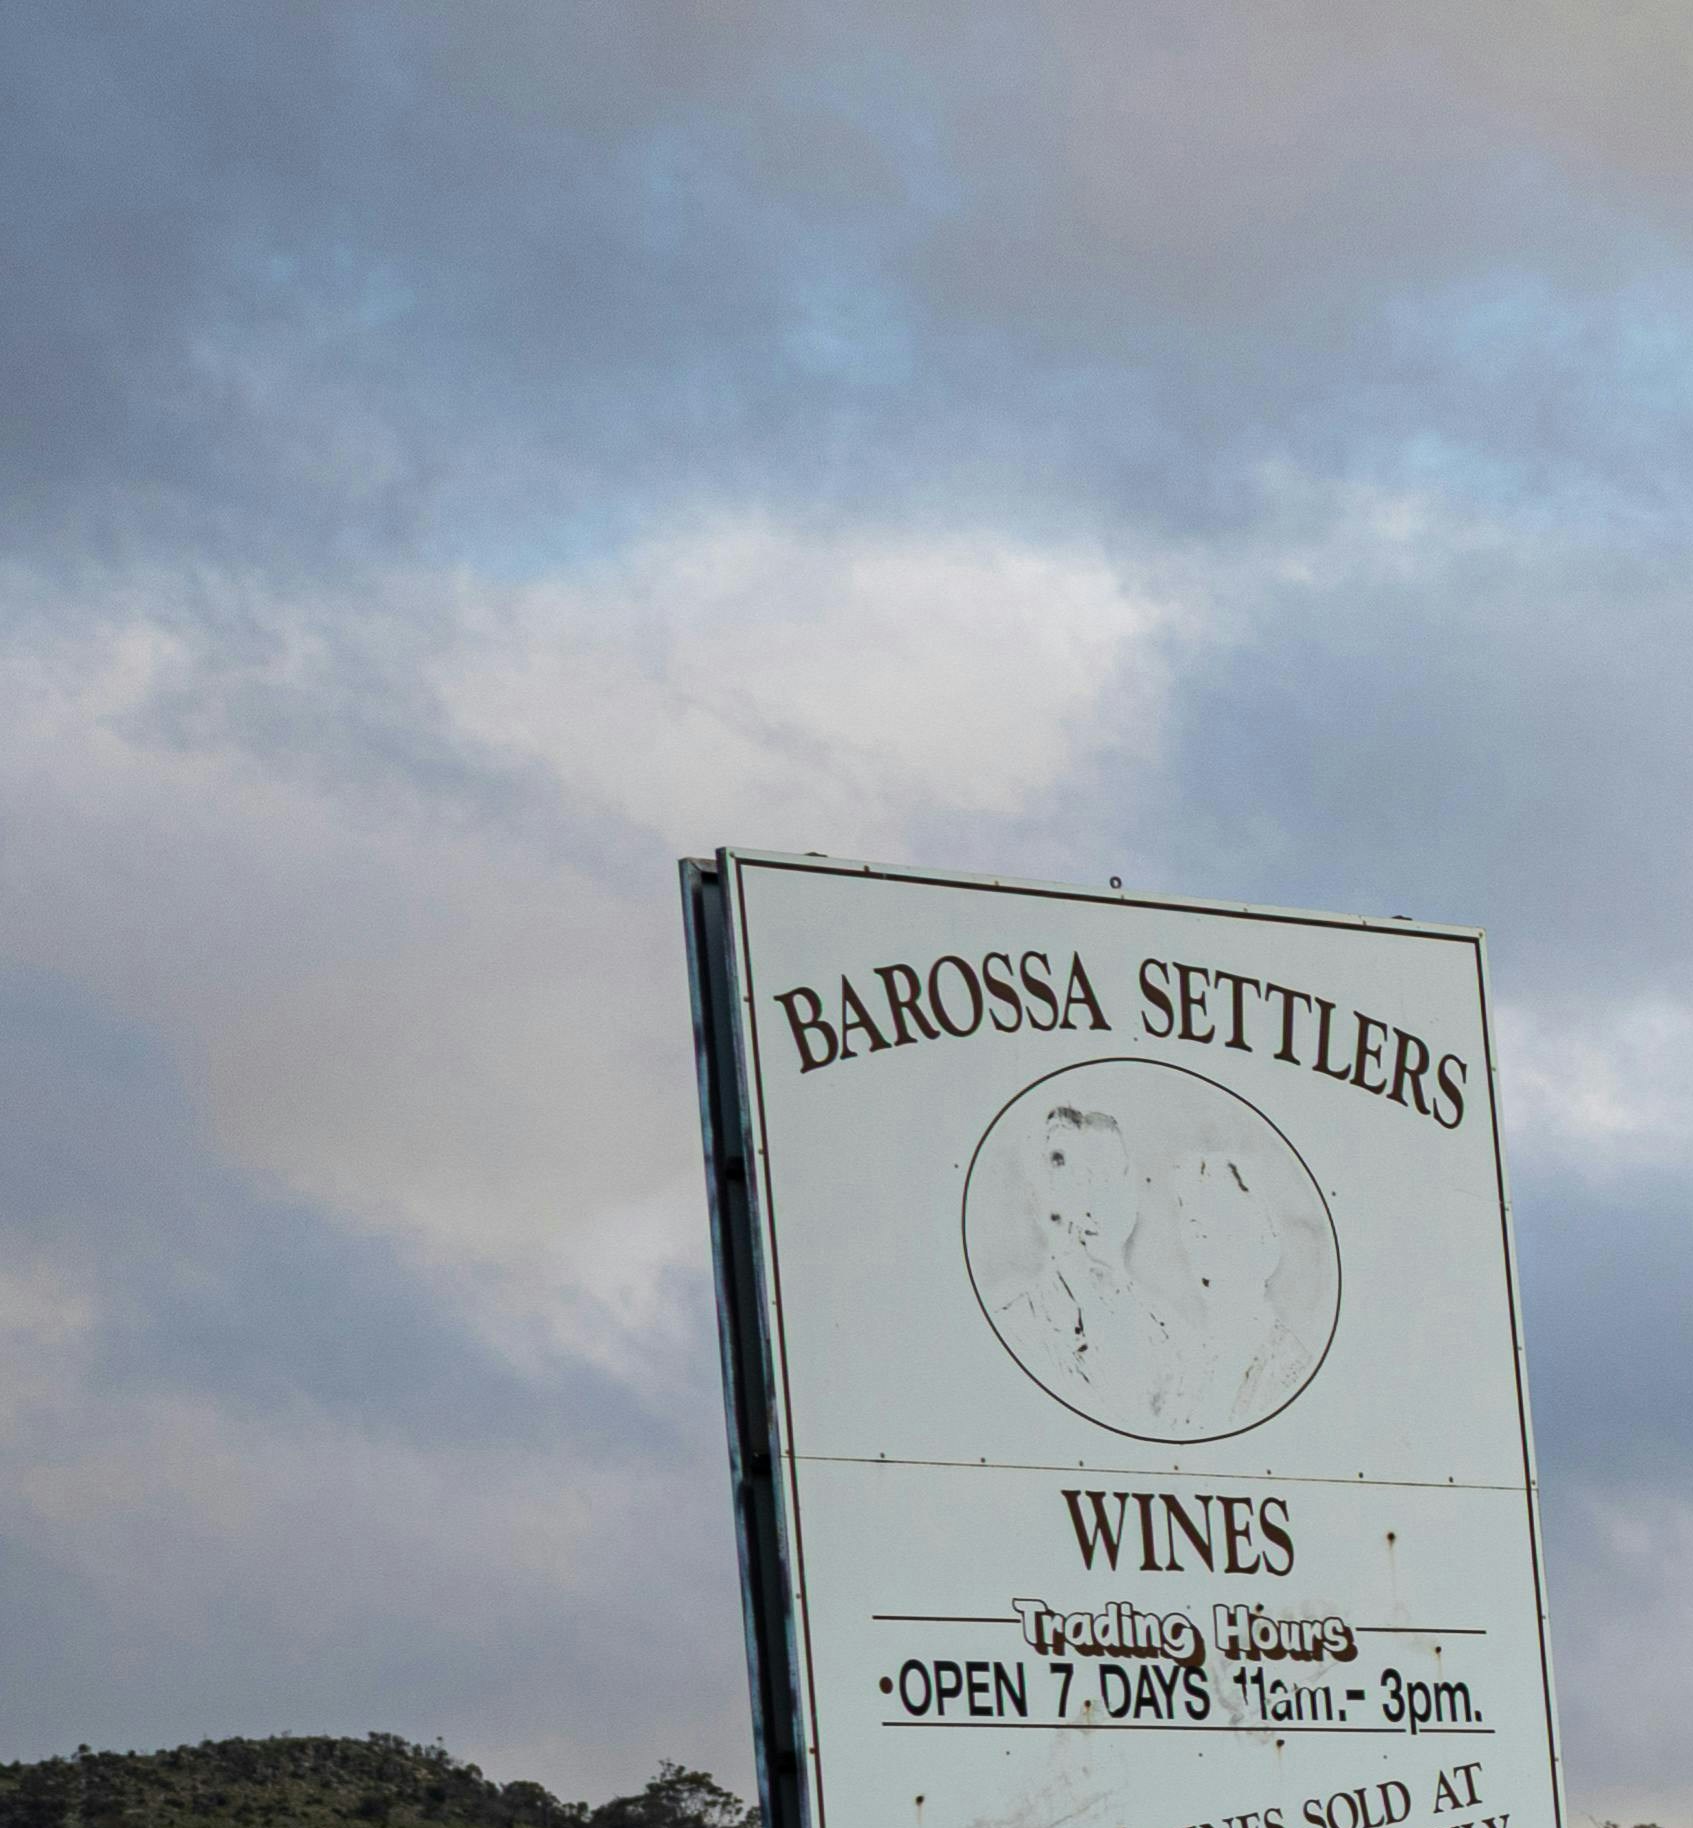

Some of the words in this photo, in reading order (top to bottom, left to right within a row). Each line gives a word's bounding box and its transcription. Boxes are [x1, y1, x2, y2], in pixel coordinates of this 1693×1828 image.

[774, 951, 1112, 1075] BAROSSA
[1138, 958, 1467, 1130] SETTLERS
[1061, 1490, 1295, 1577] WINES
[1012, 1598, 1206, 1668] Trading
[1213, 1603, 1358, 1662] Hours
[899, 1659, 1028, 1717] OPEN
[1050, 1663, 1074, 1718] 7
[1099, 1664, 1211, 1721] DAYS
[1381, 1668, 1483, 1735] 3pm.
[1433, 1763, 1483, 1814] AT
